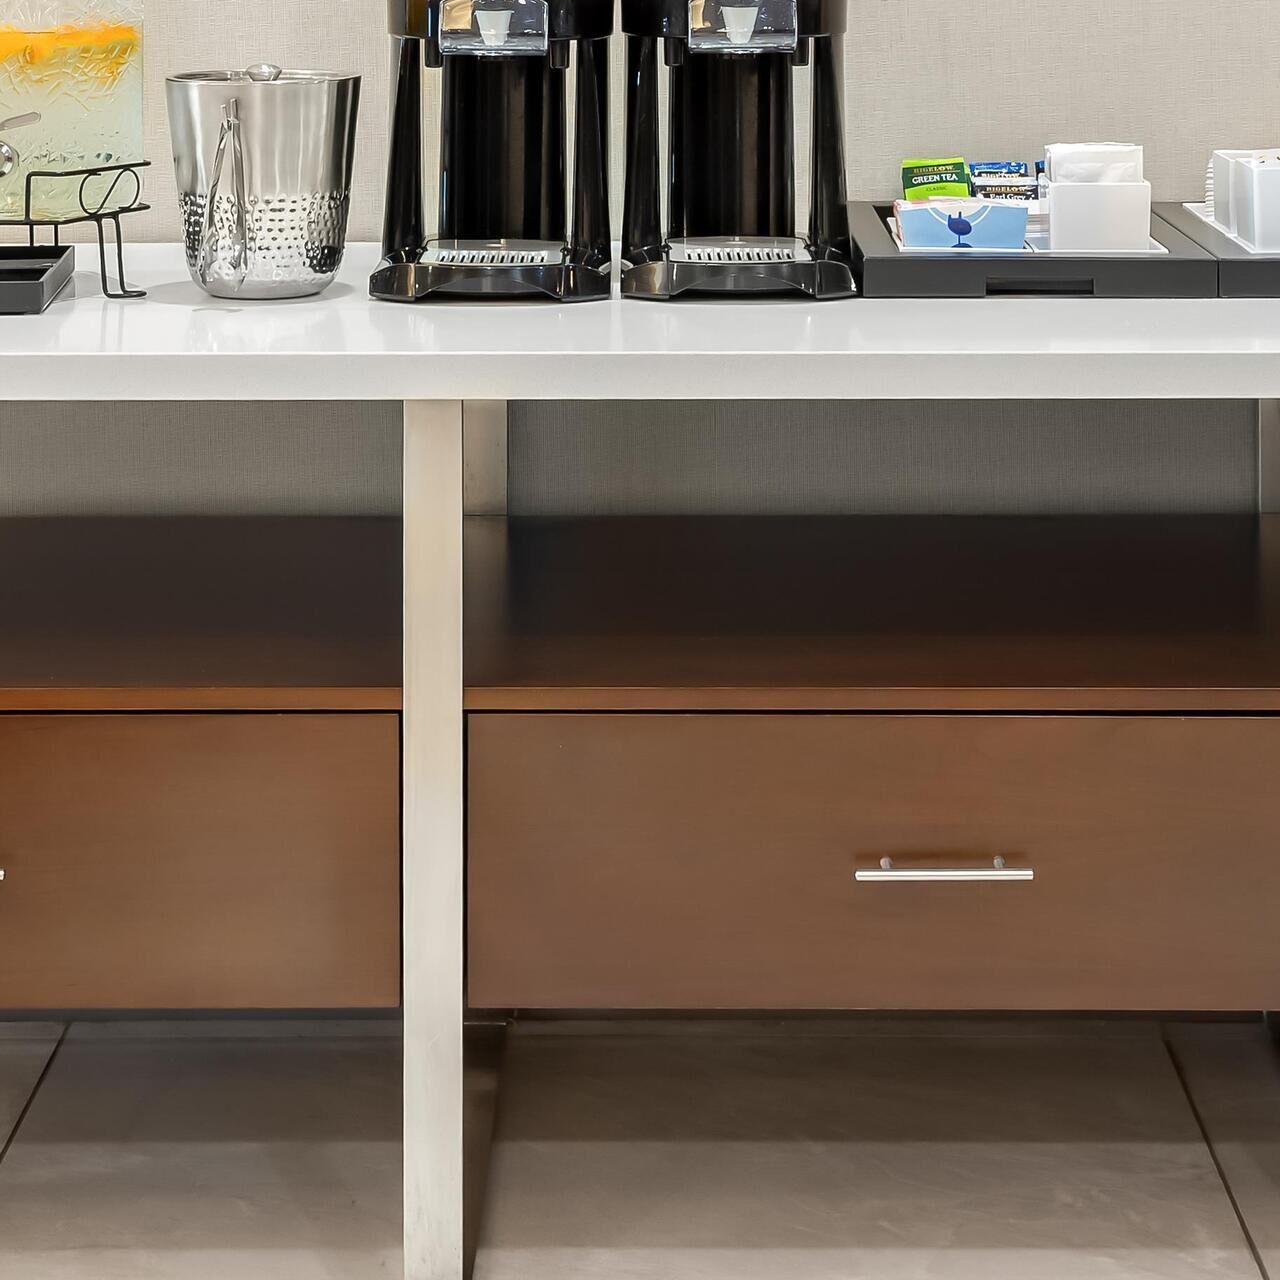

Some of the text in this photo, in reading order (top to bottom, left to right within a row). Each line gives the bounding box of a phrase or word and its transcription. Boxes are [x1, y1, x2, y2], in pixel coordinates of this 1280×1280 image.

[912, 165, 955, 174] BIGELOW
[912, 173, 959, 184] GREEN TEA
